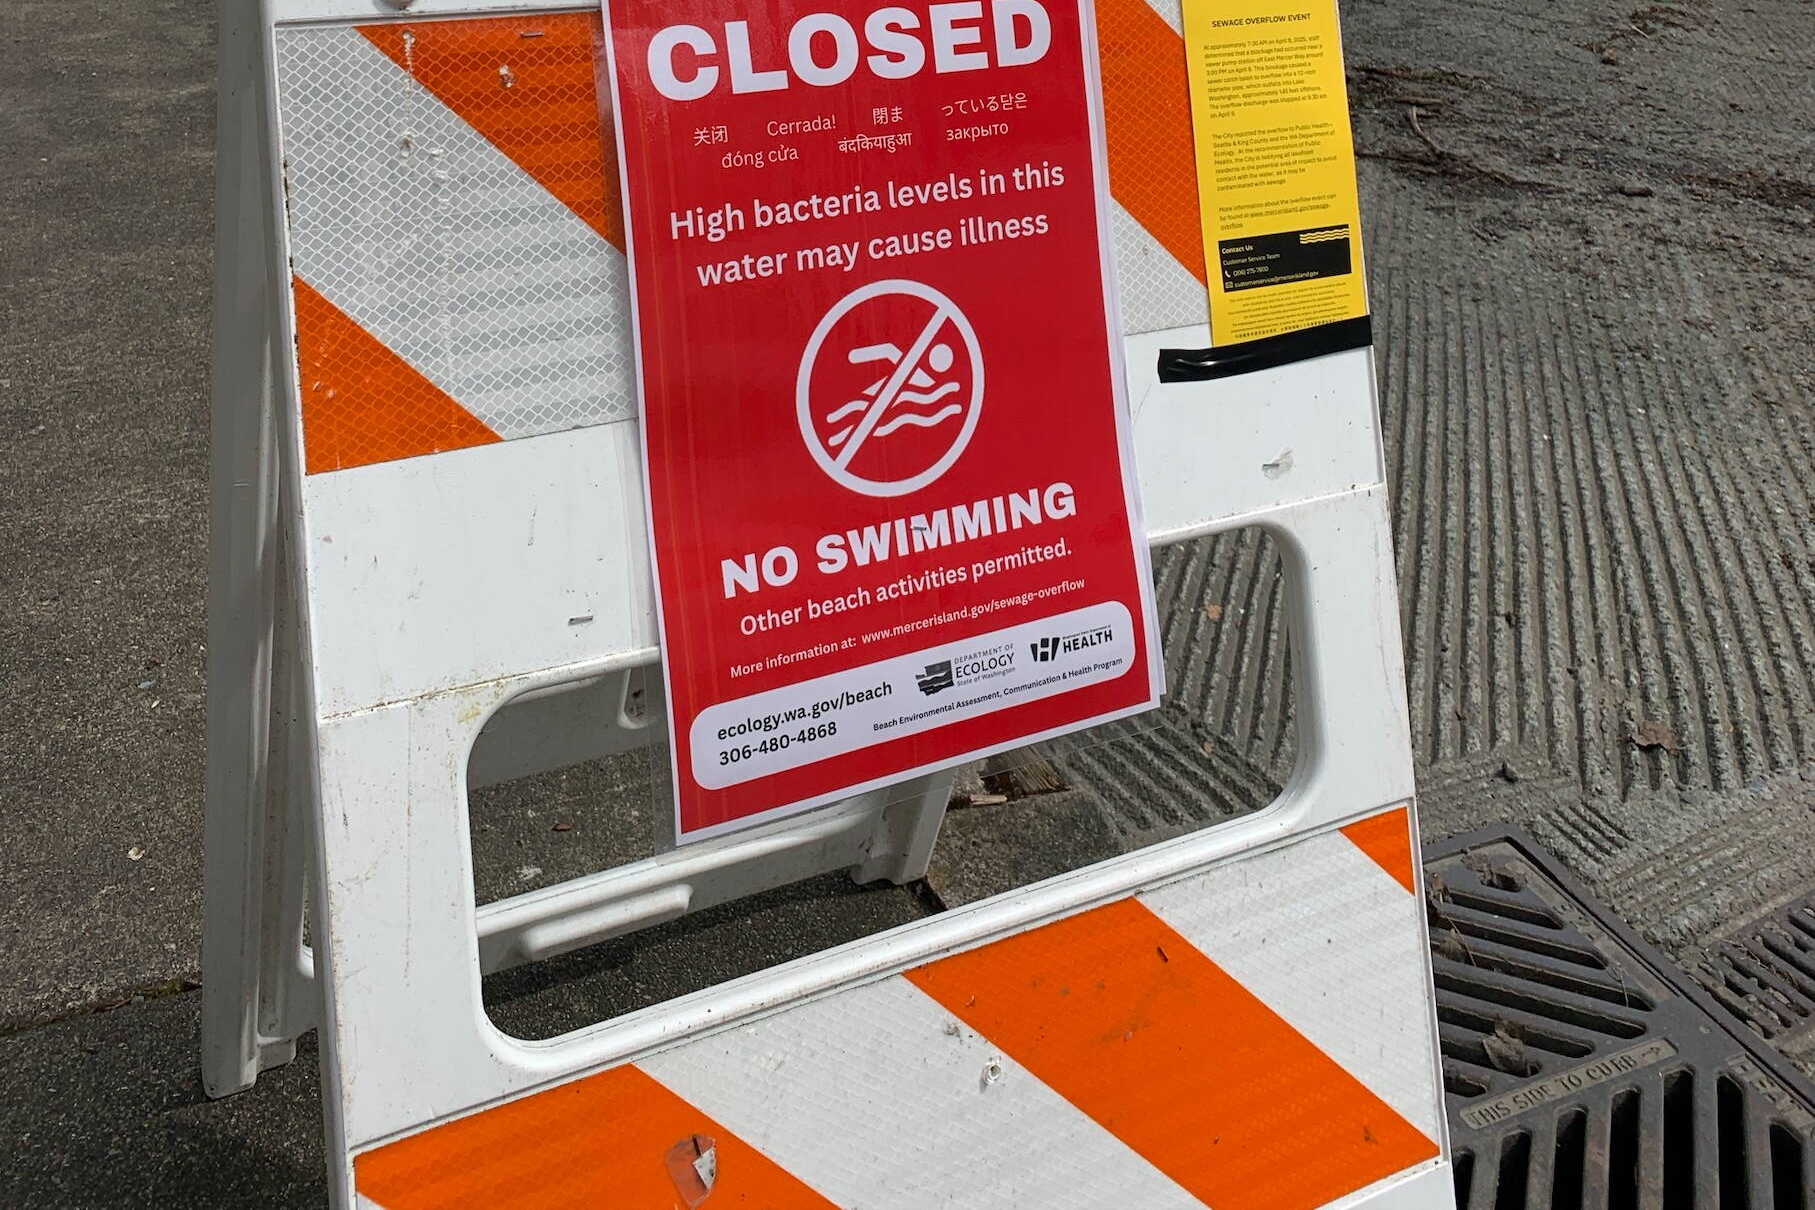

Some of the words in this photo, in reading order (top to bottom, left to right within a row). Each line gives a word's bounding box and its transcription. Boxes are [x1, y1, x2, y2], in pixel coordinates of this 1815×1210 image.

[1211, 18, 1243, 27] SEWAGE
[1244, 14, 1286, 24] OVERFLOW
[1287, 12, 1311, 21] EVENT
[694, 126, 728, 146] 关闭
[767, 114, 836, 136] Cerrada!
[946, 123, 1008, 142] закрыто
[722, 150, 764, 168] đóng
[768, 144, 799, 162] cửa
[670, 203, 744, 242] High
[754, 185, 881, 227] bacteria
[888, 173, 972, 208] levels
[980, 169, 1005, 196] in
[1012, 161, 1064, 191] this
[696, 253, 788, 286] water
[797, 242, 860, 272] may
[868, 228, 952, 259] cause
[960, 214, 1048, 246] illness
[1221, 245, 1244, 254] Contact
[1248, 254, 1265, 262] Service
[721, 546, 798, 599] NO
[816, 482, 1076, 574] SWIMMING
[740, 607, 802, 635] Other
[807, 587, 871, 619] beach
[876, 566, 967, 602] activities
[972, 537, 1072, 583] permitted.
[730, 657, 776, 678] More
[774, 642, 838, 667] information
[841, 637, 856, 649] at:
[862, 579, 1084, 644] www.mercerisland.gov/sewage-overflow
[954, 646, 1002, 665] DEPARTMENT
[1004, 643, 1013, 651] OF
[1063, 629, 1112, 654] HEALTH
[956, 652, 1014, 678] ECOLOGY
[957, 678, 972, 686] State
[973, 675, 980, 683] of
[981, 667, 1016, 680] Washington
[873, 718, 898, 731] Beach
[899, 702, 955, 724] Environmental
[956, 691, 1002, 709] Assessment,
[1003, 675, 1061, 696] Communication
[1062, 672, 1067, 680] &
[1068, 666, 1092, 678] Health
[1093, 658, 1122, 671] Program
[718, 682, 892, 740] ecology.wa.gov/beach
[720, 721, 837, 766] 306-480-4868
[1468, 1101, 1511, 1126] THIS
[1512, 1085, 1552, 1111] SIDE
[1556, 1073, 1583, 1093] TO
[1586, 1054, 1636, 1082] CURB
